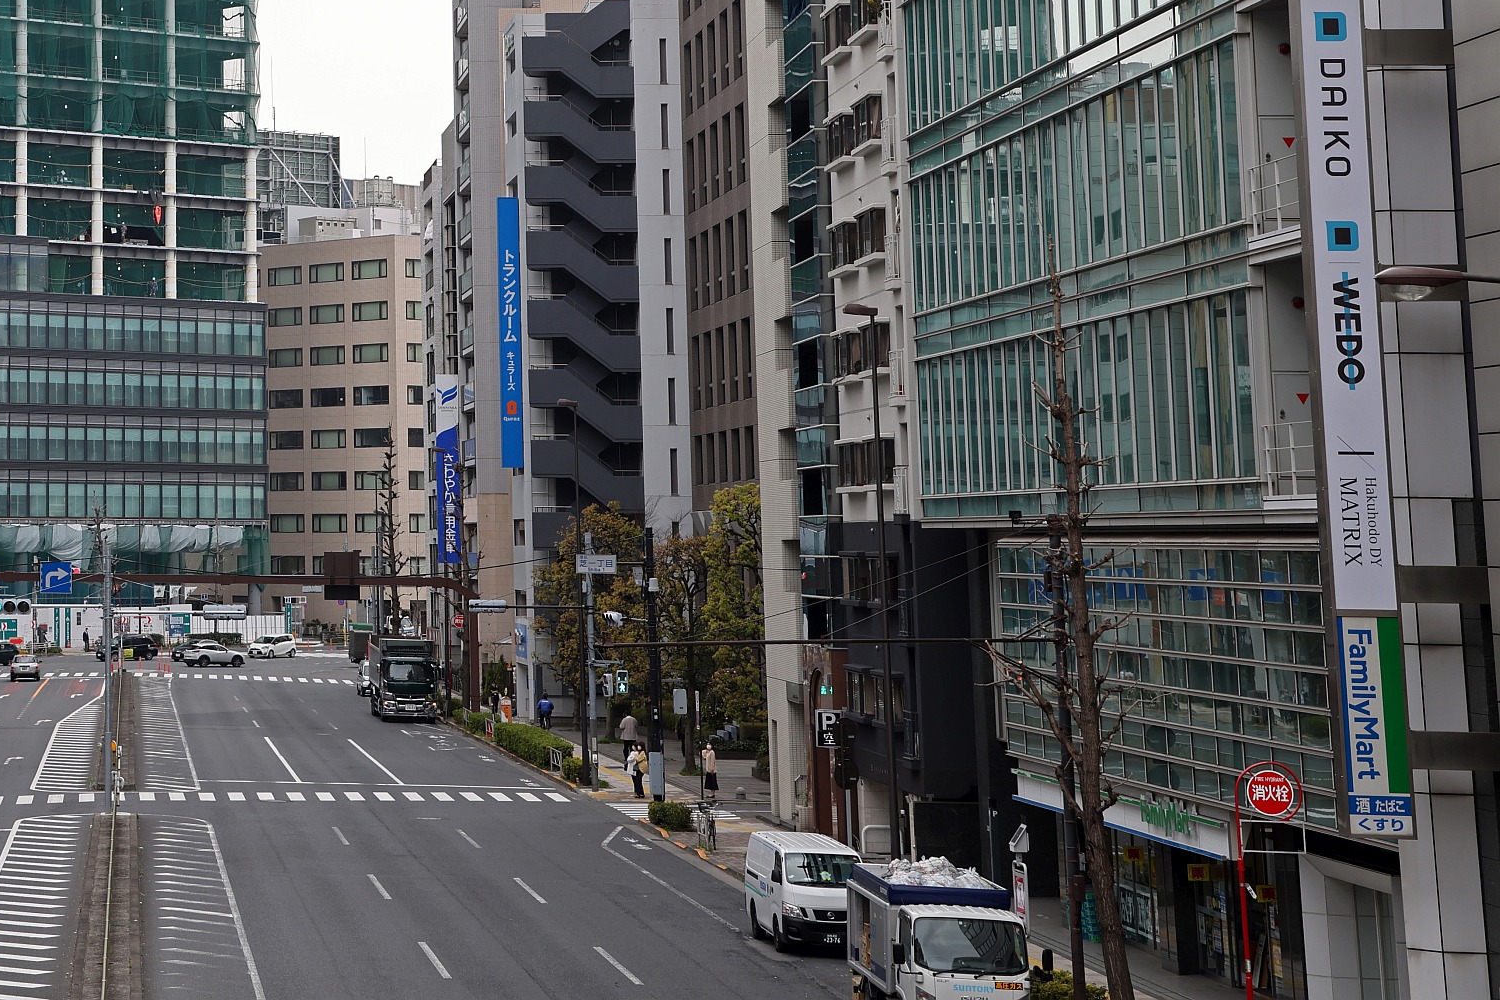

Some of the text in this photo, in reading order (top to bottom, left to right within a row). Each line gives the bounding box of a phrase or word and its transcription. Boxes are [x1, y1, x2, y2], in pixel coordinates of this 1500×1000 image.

[1319, 57, 1352, 178] DAIKO
[503, 249, 517, 391] トランクルーム キュラーズ
[1332, 277, 1365, 385] WEDO
[1340, 476, 1363, 567] MATRIX
[1365, 477, 1382, 567] Hakuhodo DY
[580, 560, 613, 568] 芝一丁目
[1347, 629, 1381, 781] FamilyMart
[821, 713, 836, 731] P
[823, 732, 836, 745] 空
[1252, 784, 1289, 802] 消火栓
[1356, 797, 1406, 813] 酒 たばこ
[1140, 795, 1191, 837] FamilyMart
[1358, 817, 1404, 833] くすり
[953, 984, 995, 993] SUNTORY
